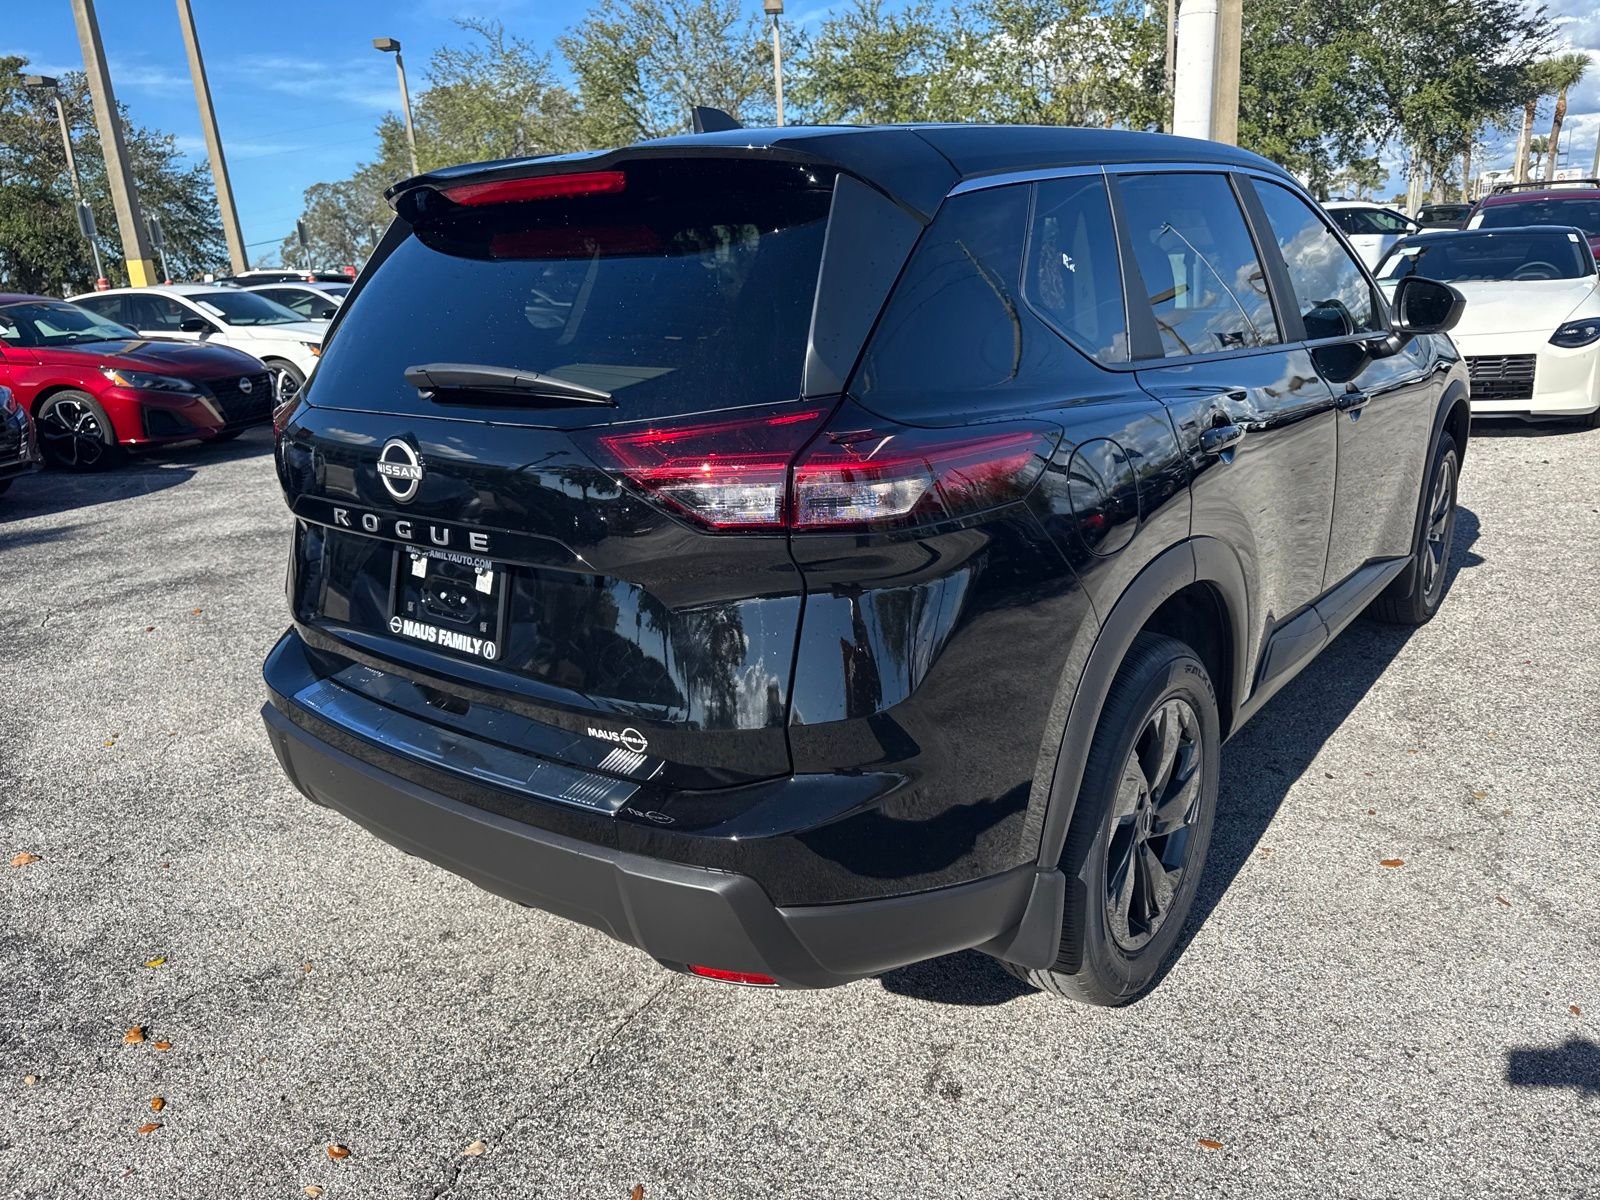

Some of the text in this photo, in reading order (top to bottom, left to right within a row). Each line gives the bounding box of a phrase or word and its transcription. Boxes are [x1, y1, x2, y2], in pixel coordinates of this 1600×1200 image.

[377, 462, 420, 478] NISSAN
[333, 507, 489, 552] ROGUE
[406, 545, 492, 570] MAFAMILYAUTO.COM
[403, 620, 482, 655] MAUS FAMILY
[588, 727, 648, 745] MAUS NISSAN
